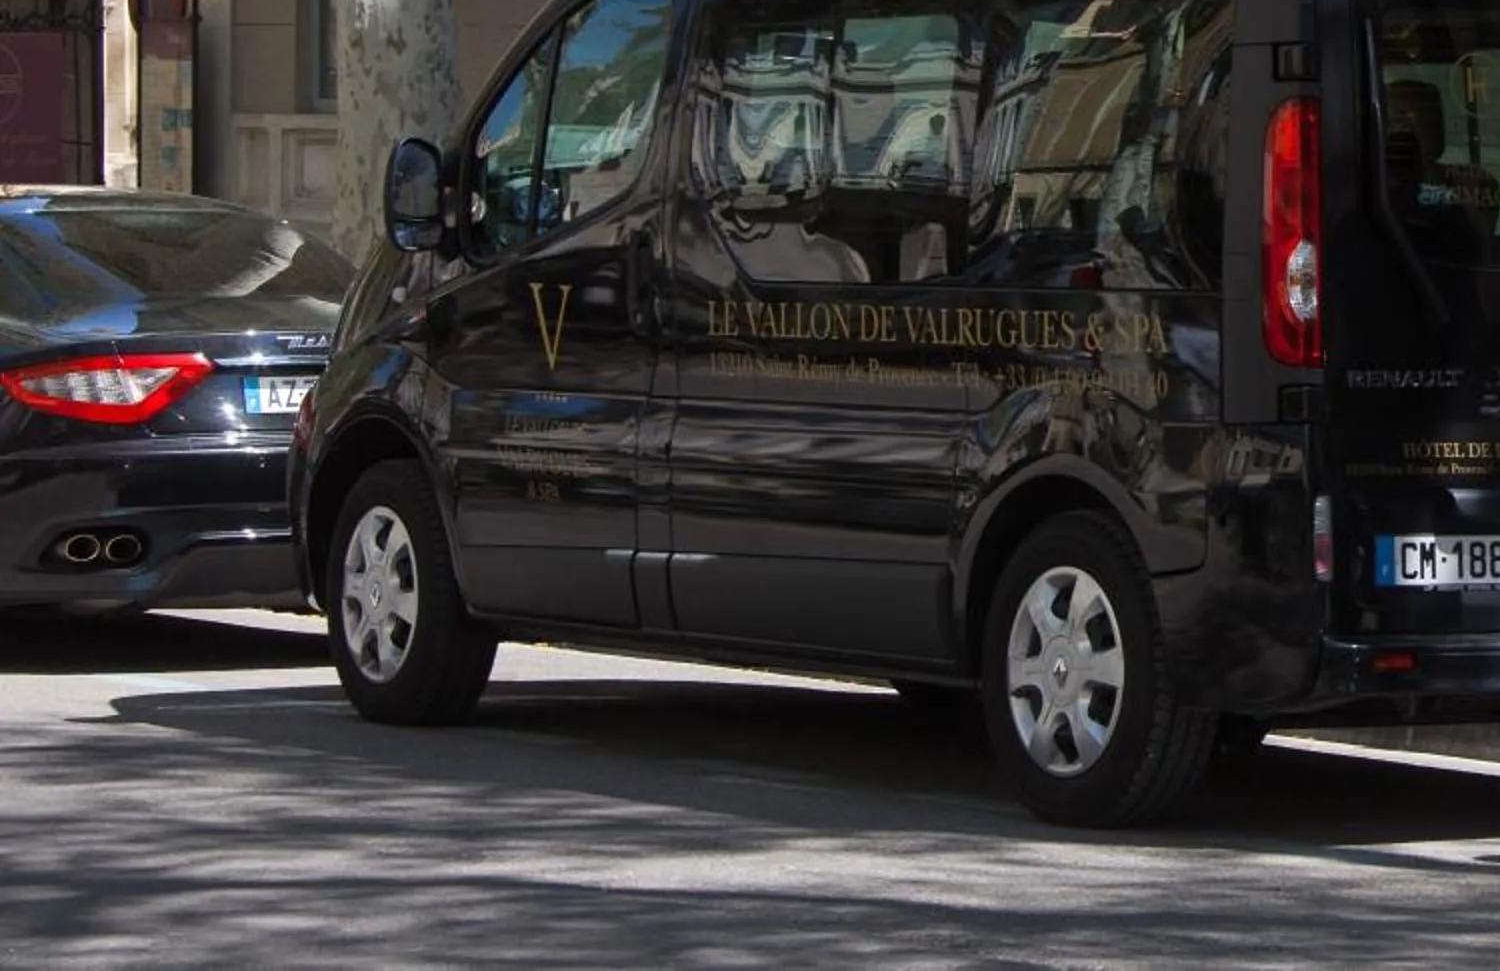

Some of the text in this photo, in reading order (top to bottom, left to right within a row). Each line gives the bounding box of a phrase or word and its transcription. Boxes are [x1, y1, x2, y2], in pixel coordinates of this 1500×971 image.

[528, 282, 573, 370] V
[707, 300, 1168, 354] LE VALLON DE VALRUGUES & SPA
[1347, 369, 1465, 389] RENAULT
[1468, 441, 1492, 458] DE
